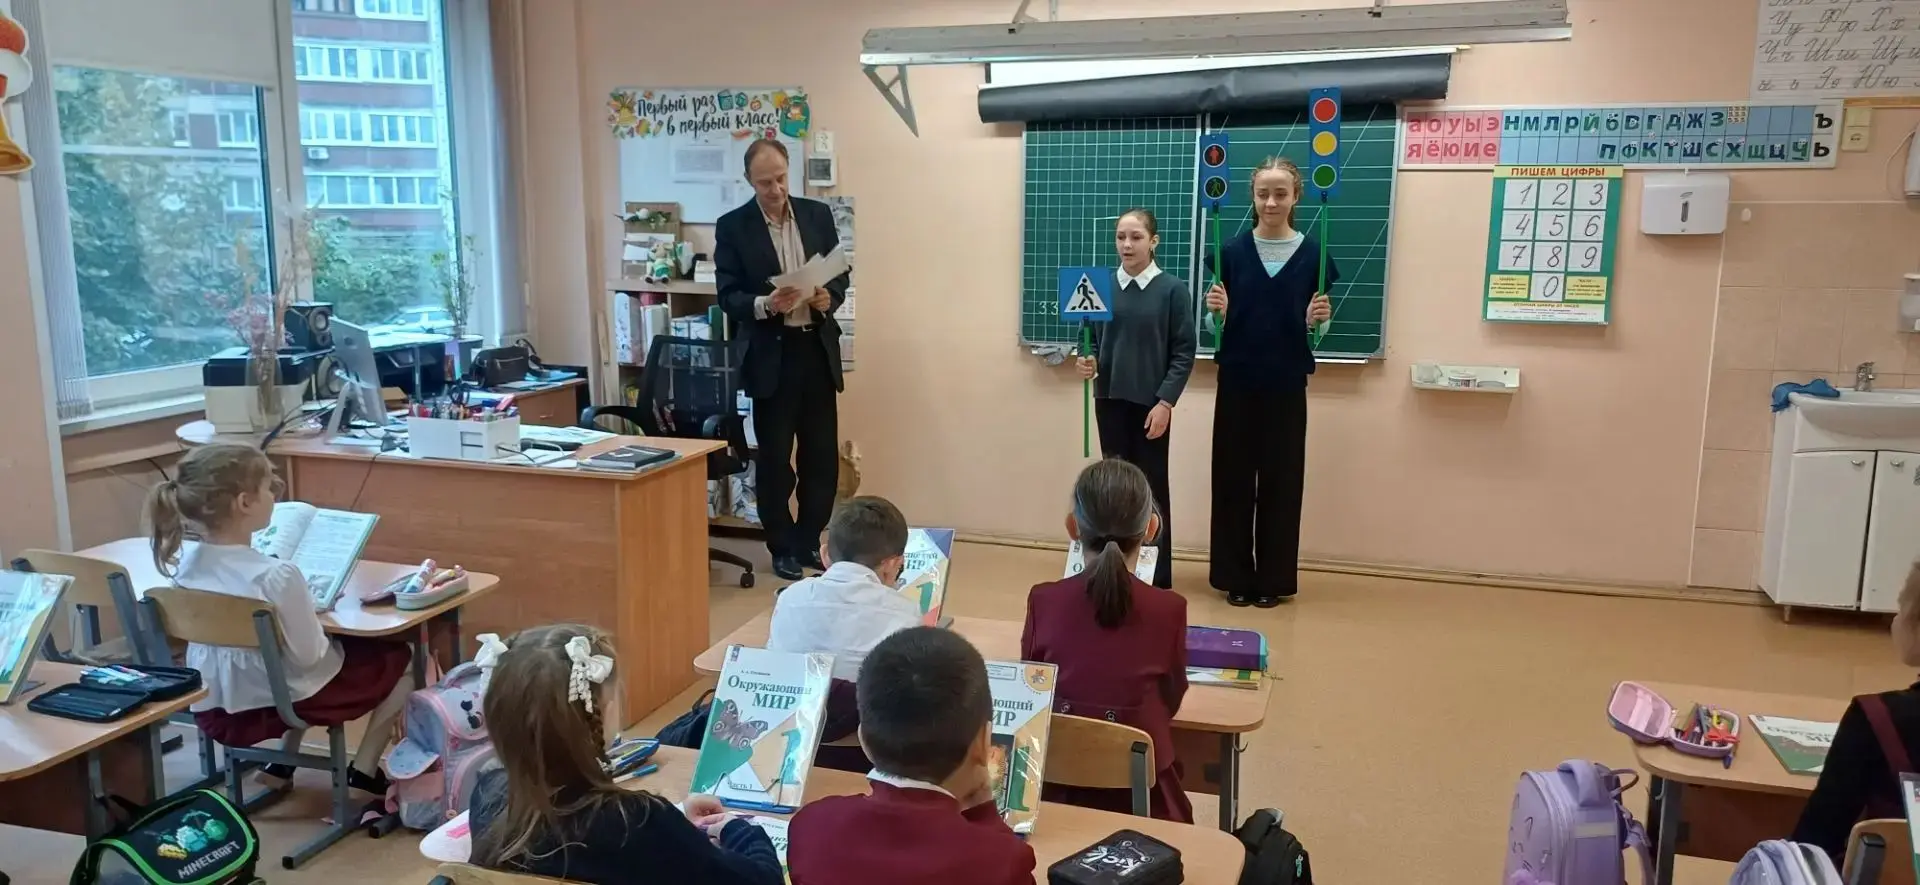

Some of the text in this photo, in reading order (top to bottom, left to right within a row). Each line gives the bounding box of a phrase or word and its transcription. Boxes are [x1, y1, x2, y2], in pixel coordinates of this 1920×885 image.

[638, 94, 717, 121] Первый раз
[667, 108, 780, 139] в первый класс!
[1511, 168, 1605, 177] ПИШЕМ ЦИФРЫ
[1520, 183, 1603, 206] 1 2 3
[1516, 214, 1600, 237] 4 5 6
[1512, 245, 1597, 268] 7 8 9
[1543, 276, 1558, 298] 0
[752, 692, 796, 710] МИР
[993, 709, 1016, 726] ИР
[178, 841, 240, 879] MINECRAFT
